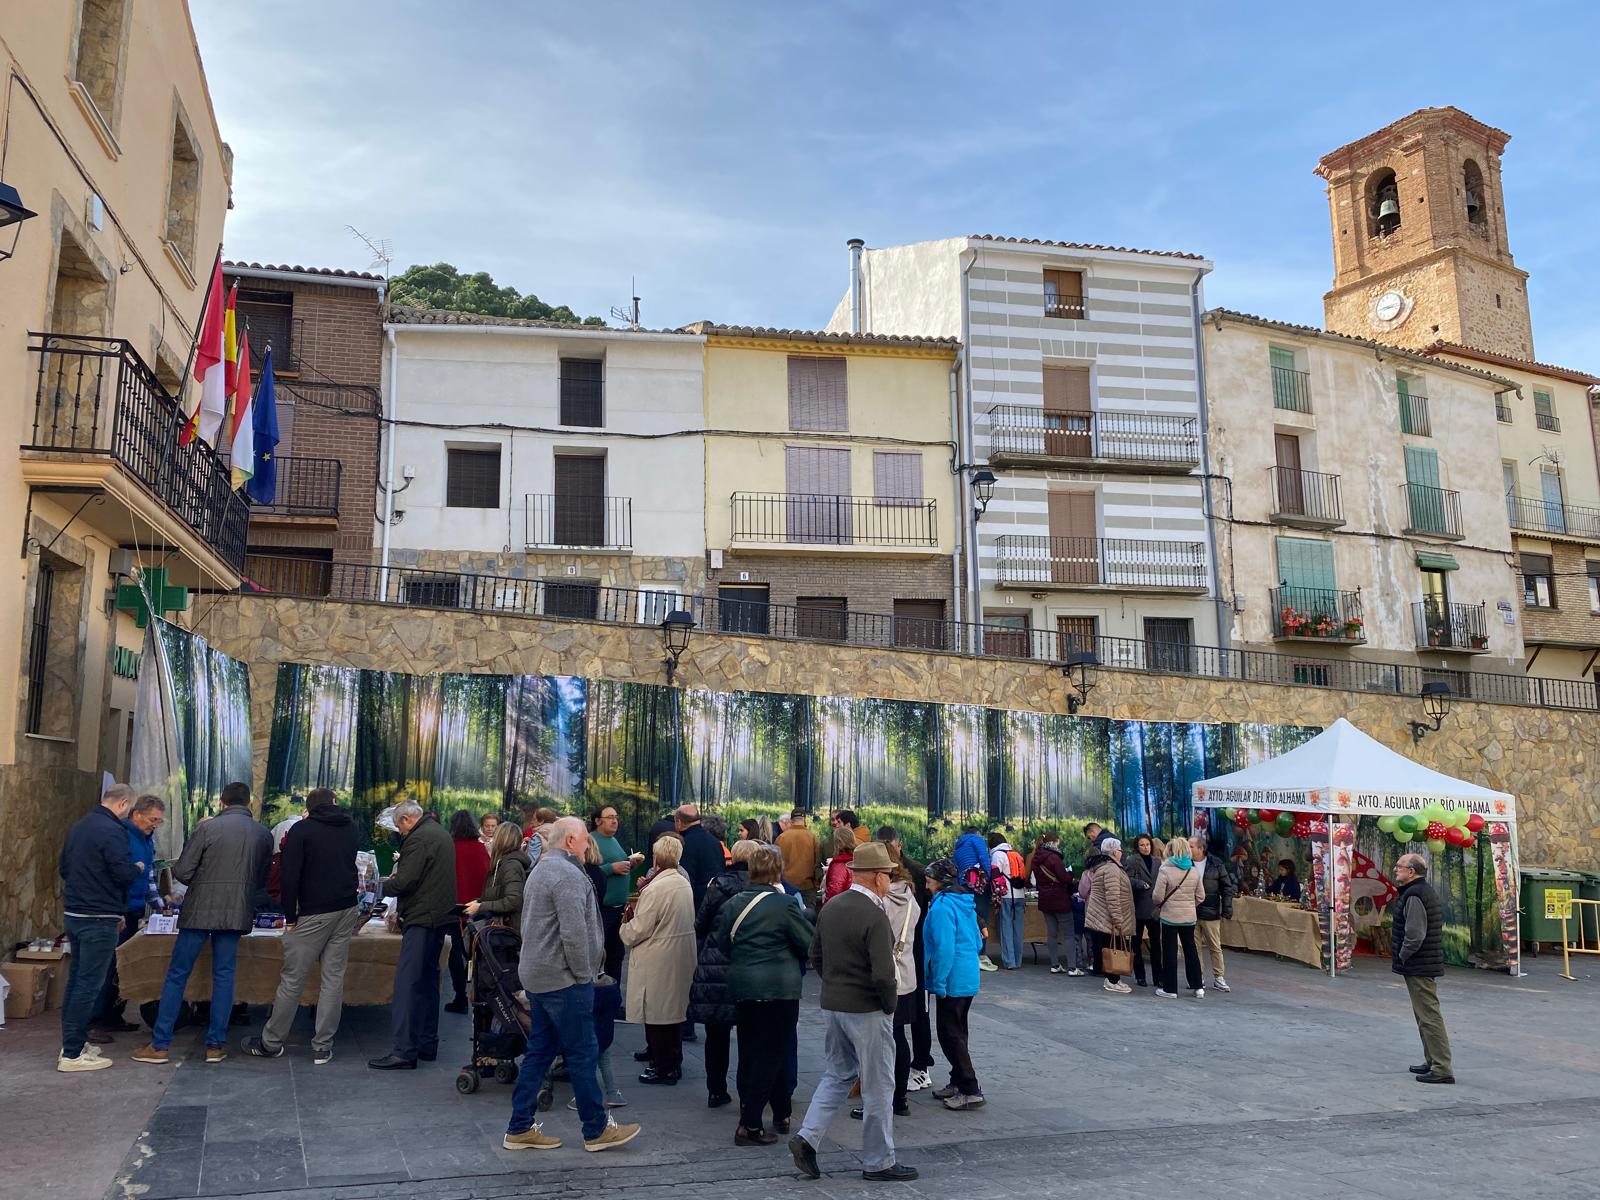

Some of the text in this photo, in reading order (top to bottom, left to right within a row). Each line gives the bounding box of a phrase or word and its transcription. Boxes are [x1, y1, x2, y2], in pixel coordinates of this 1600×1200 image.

[1208, 789, 1306, 805] AYTO. AGUILAR DEL RÍO ALHAMA
[1357, 794, 1382, 809] AYTO.
[1384, 795, 1421, 810] AGUILAR
[1440, 796, 1455, 812] RÍO
